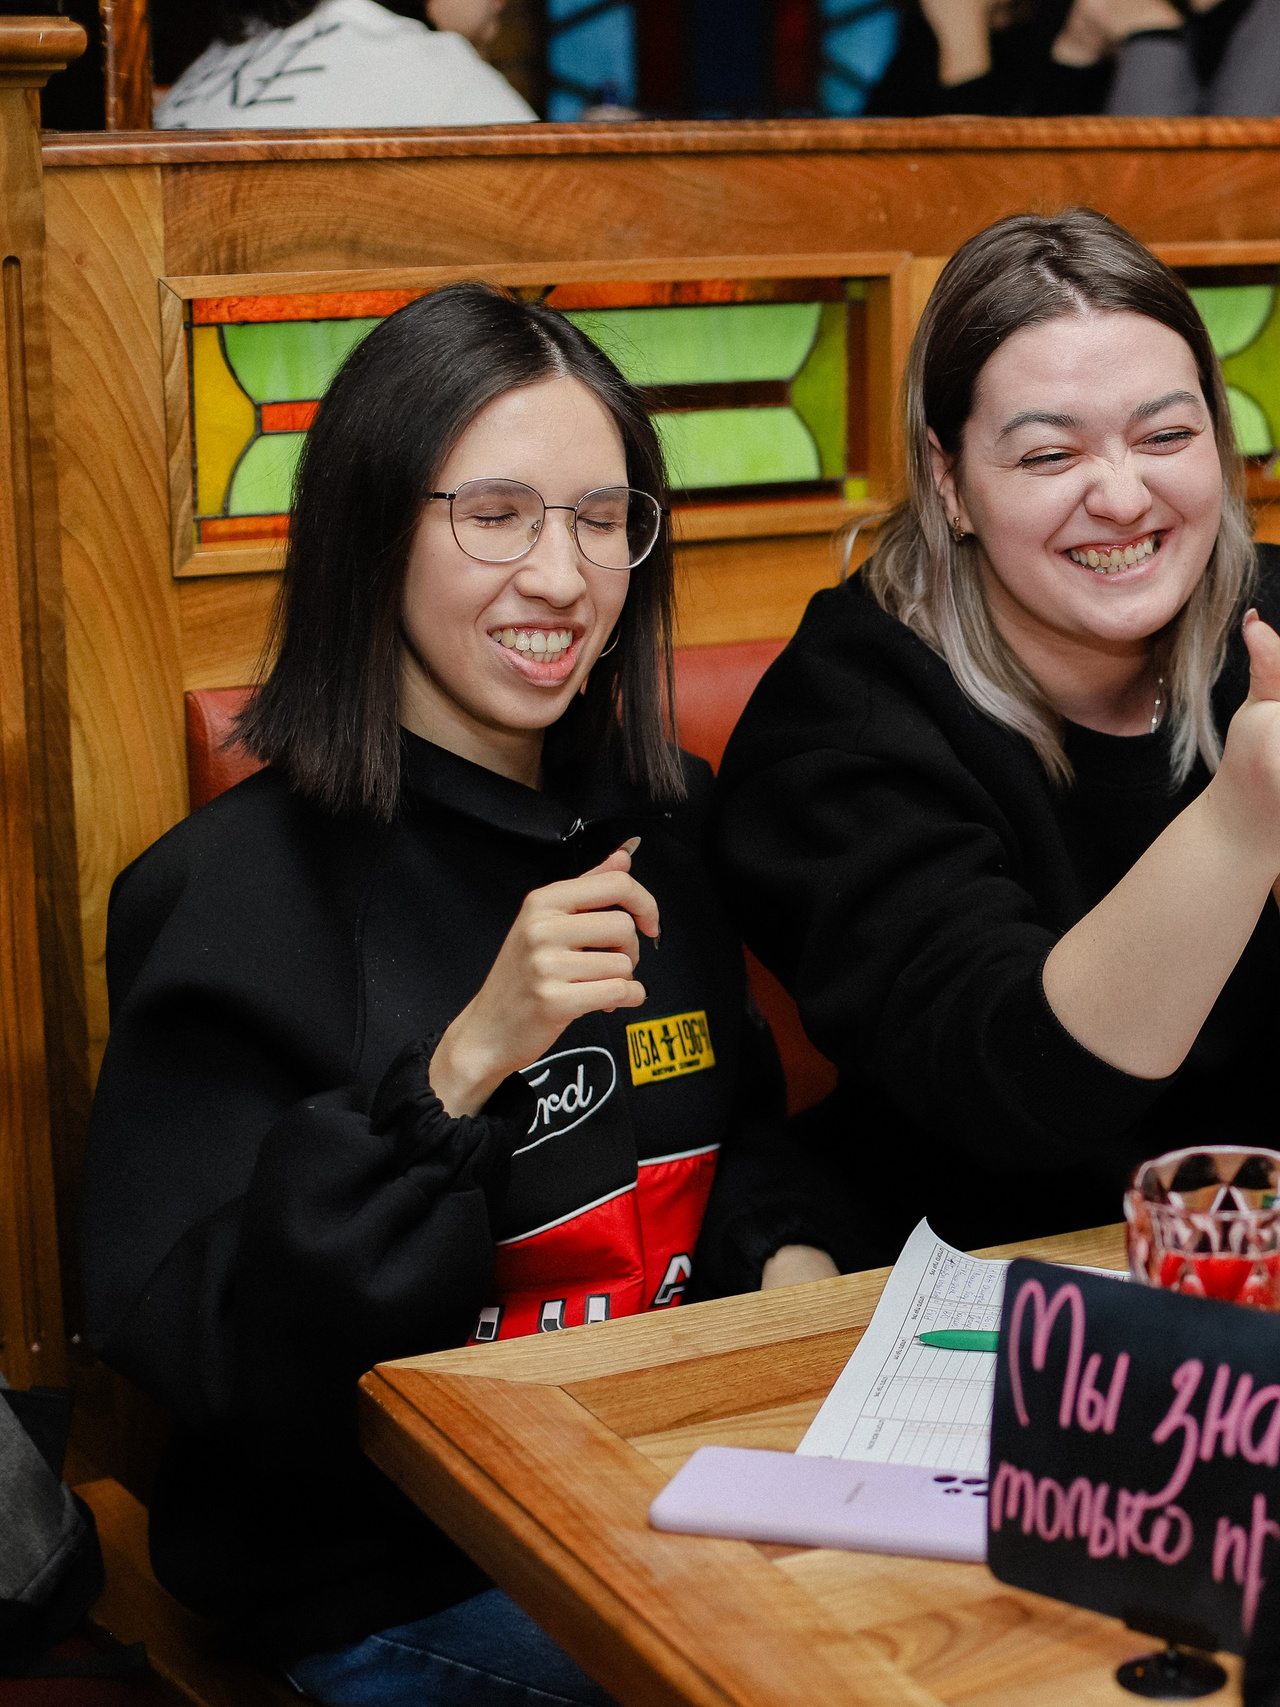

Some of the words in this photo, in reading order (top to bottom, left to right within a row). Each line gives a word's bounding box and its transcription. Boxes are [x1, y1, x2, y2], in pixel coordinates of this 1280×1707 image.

[630, 1029, 661, 1068] USA
[527, 1063, 594, 1135] rd
[1008, 1278, 1131, 1435] Мы
